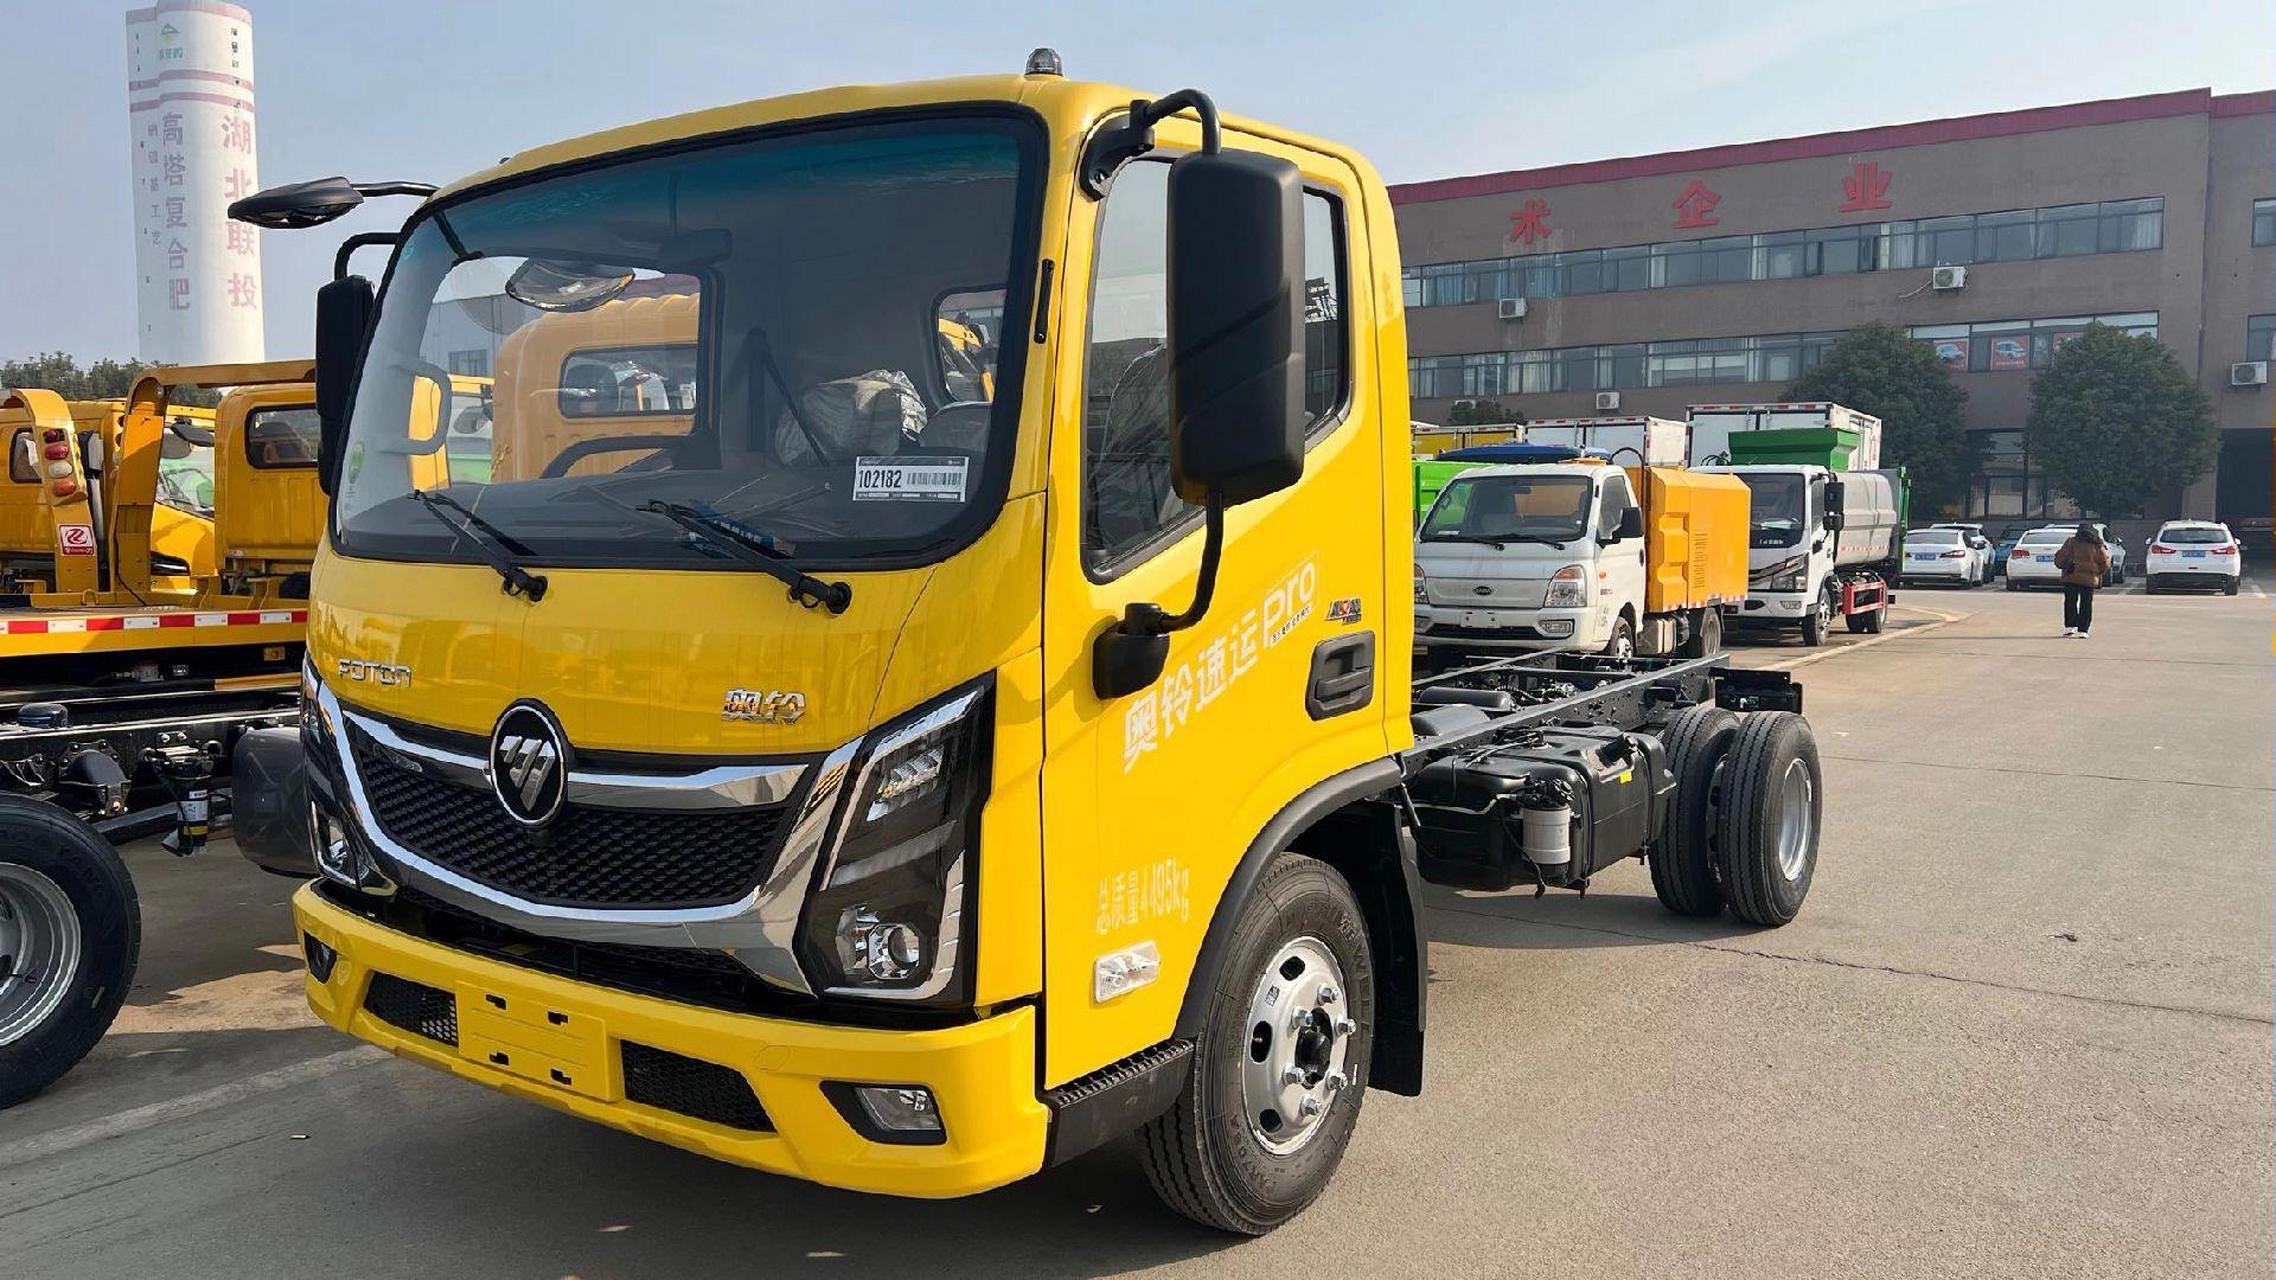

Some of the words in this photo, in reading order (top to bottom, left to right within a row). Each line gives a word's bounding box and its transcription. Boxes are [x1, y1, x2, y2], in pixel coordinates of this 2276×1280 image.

[221, 114, 257, 310] 湖北联投
[859, 469, 902, 489] 102182
